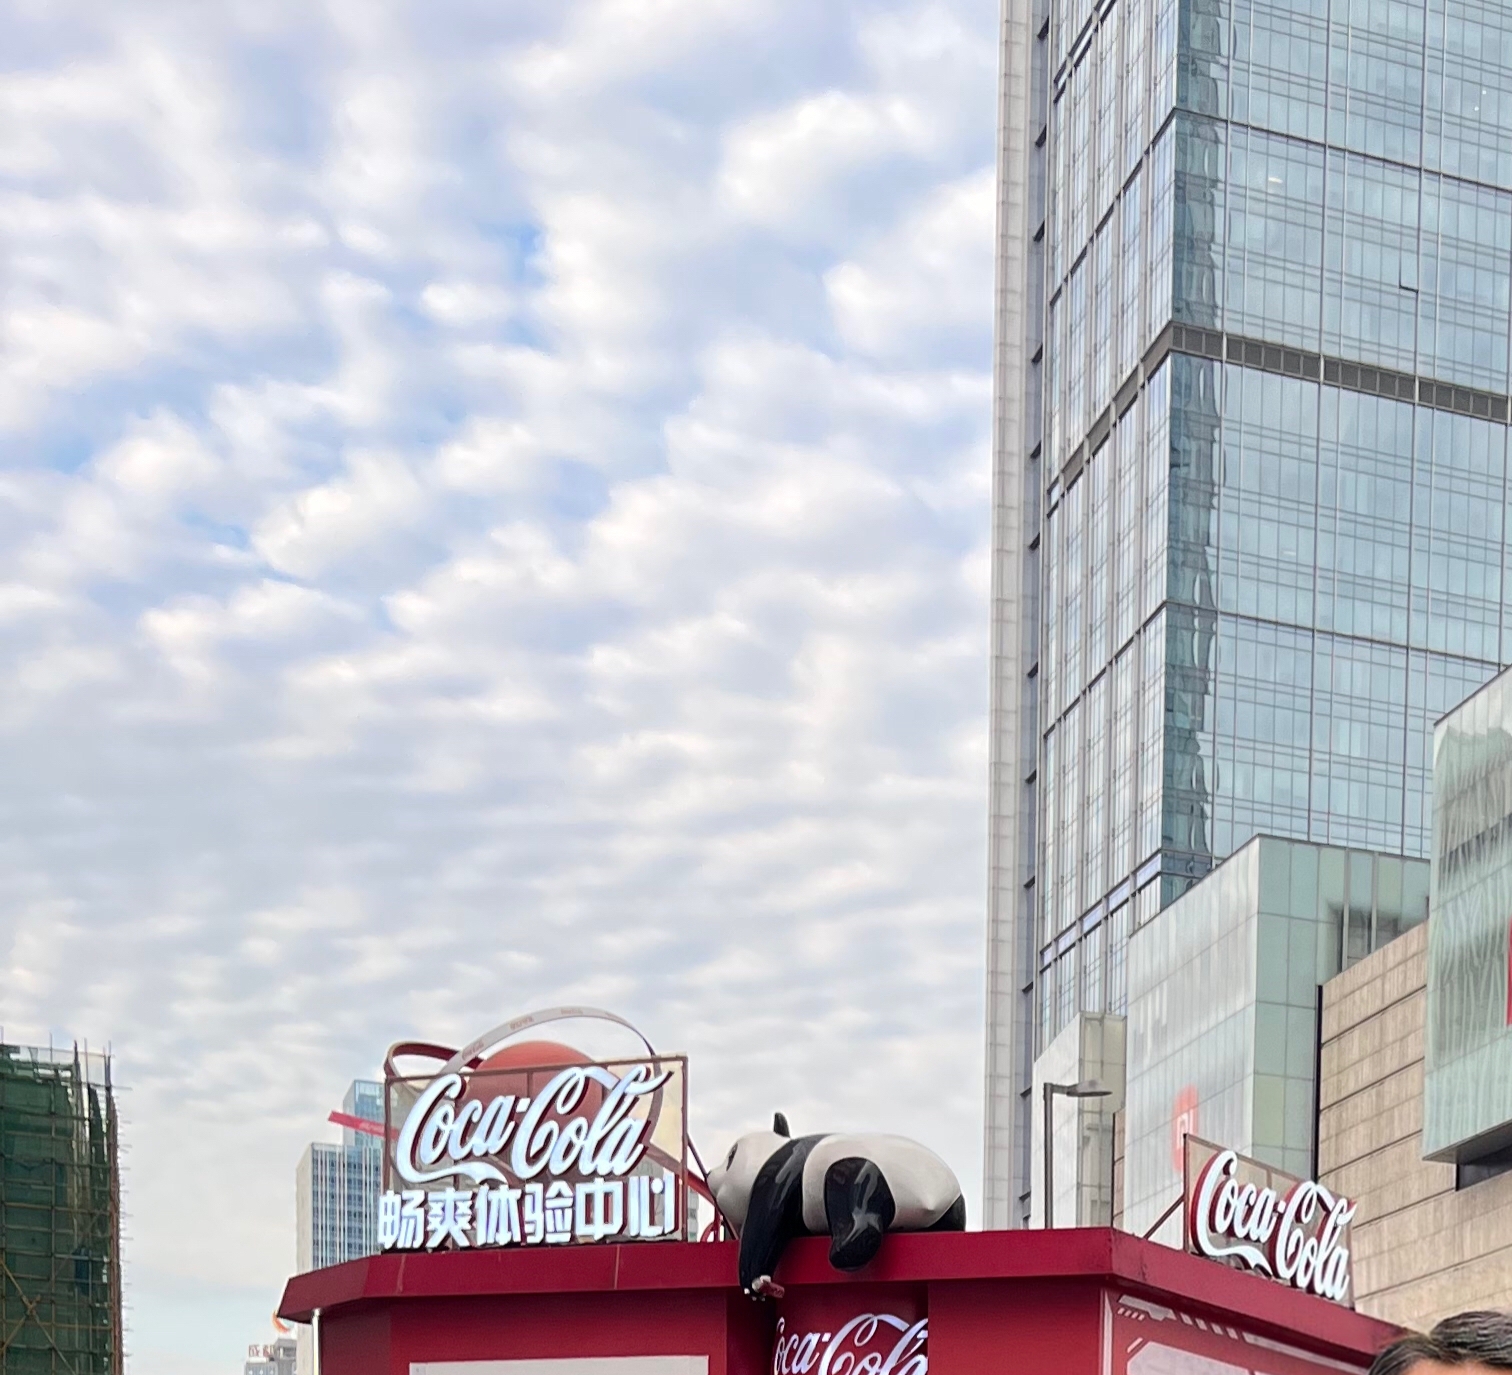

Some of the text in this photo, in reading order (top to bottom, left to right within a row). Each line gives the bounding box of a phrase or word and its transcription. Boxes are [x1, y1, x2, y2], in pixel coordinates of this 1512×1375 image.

[399, 1065, 674, 1185] Coca-Cola
[377, 1172, 676, 1250] 畅爽体验中心
[1194, 1149, 1357, 1302] Coca-Cola
